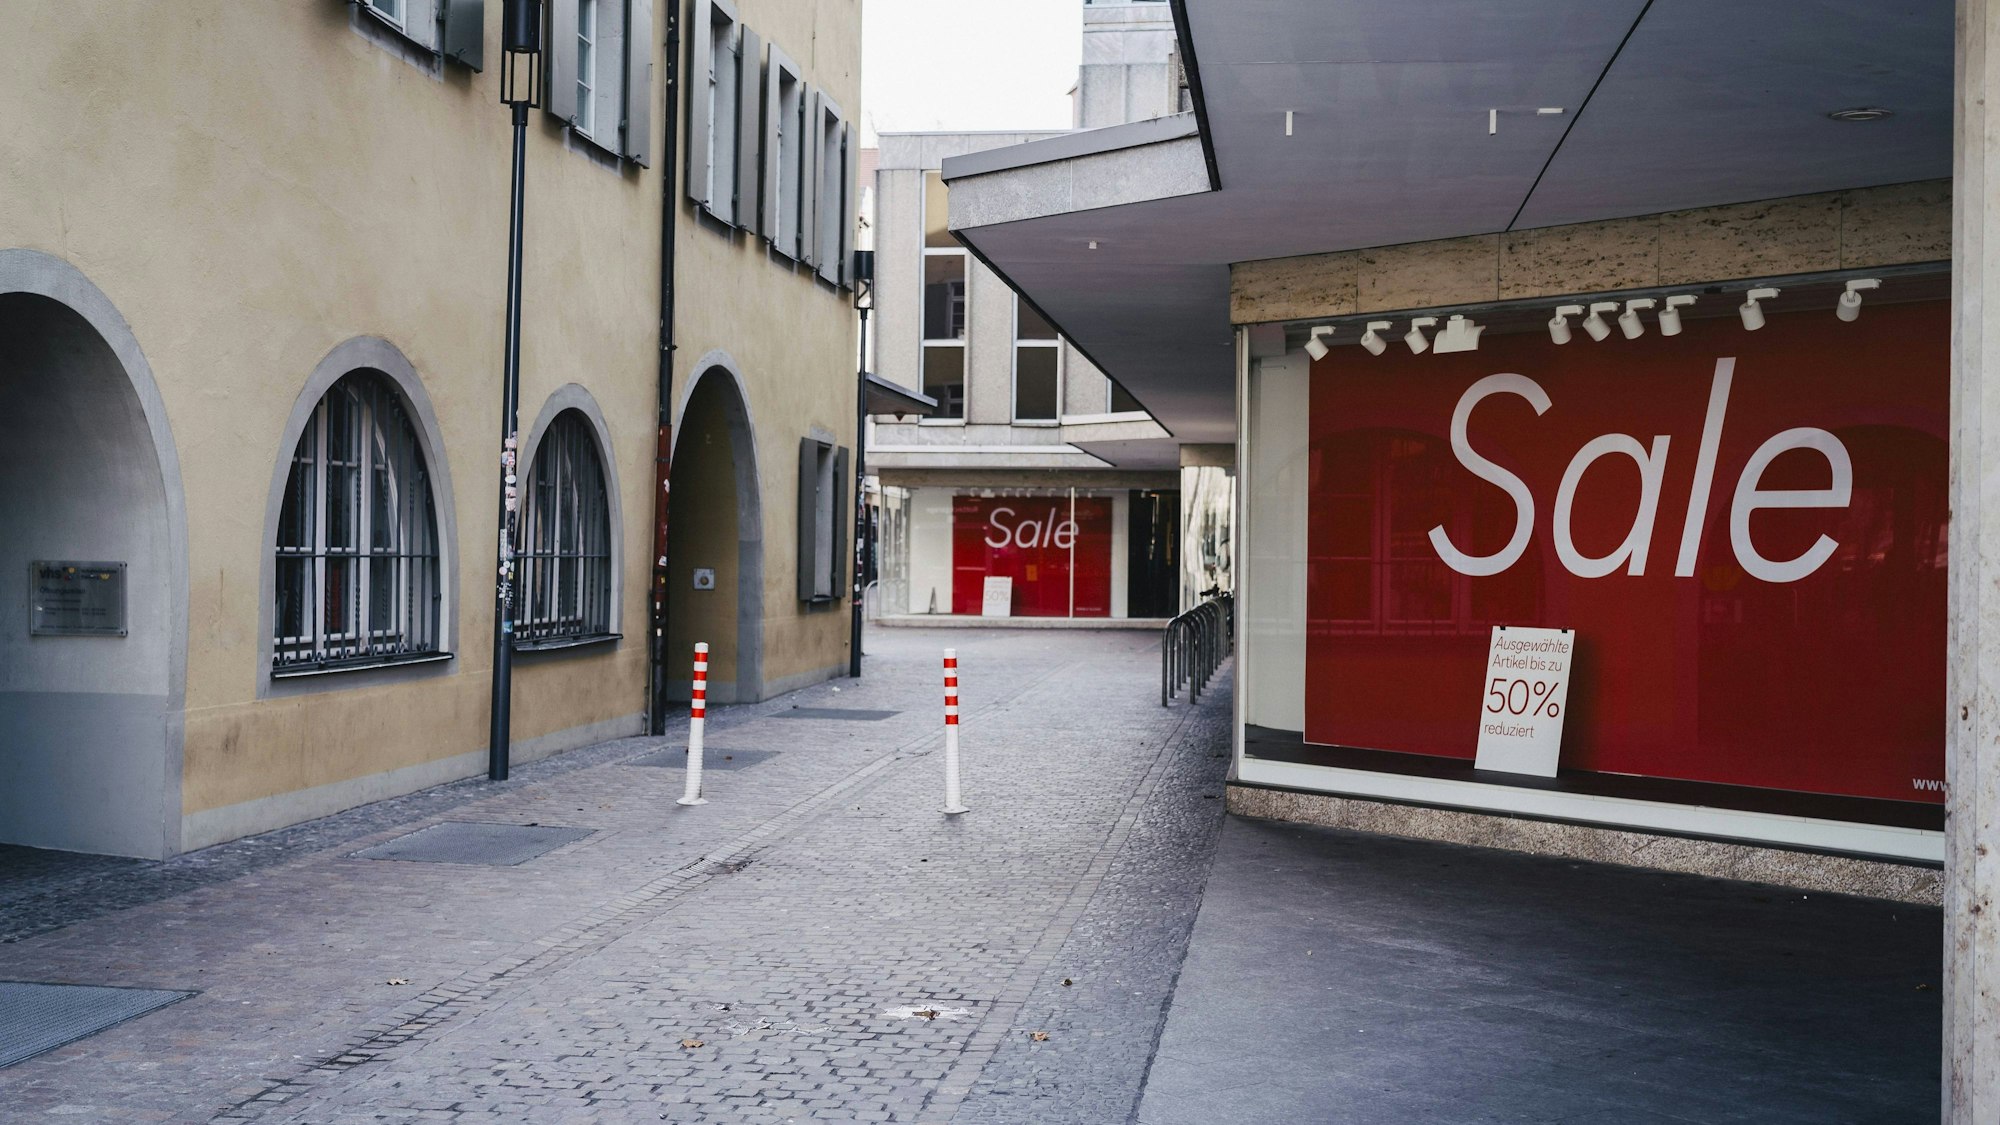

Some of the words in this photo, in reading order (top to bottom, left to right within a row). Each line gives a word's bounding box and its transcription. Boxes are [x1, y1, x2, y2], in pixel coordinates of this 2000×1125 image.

[1427, 357, 1853, 583] Sale
[984, 507, 1079, 549] Sale
[40, 567, 62, 579] vhs
[985, 590, 1009, 602] 50%
[1494, 636, 1570, 654] Ausgewählte
[1492, 654, 1528, 669] Artikel
[1530, 656, 1546, 670] bis
[1548, 661, 1562, 672] zu
[1486, 678, 1560, 718] 50%
[1484, 721, 1535, 739] reduziert
